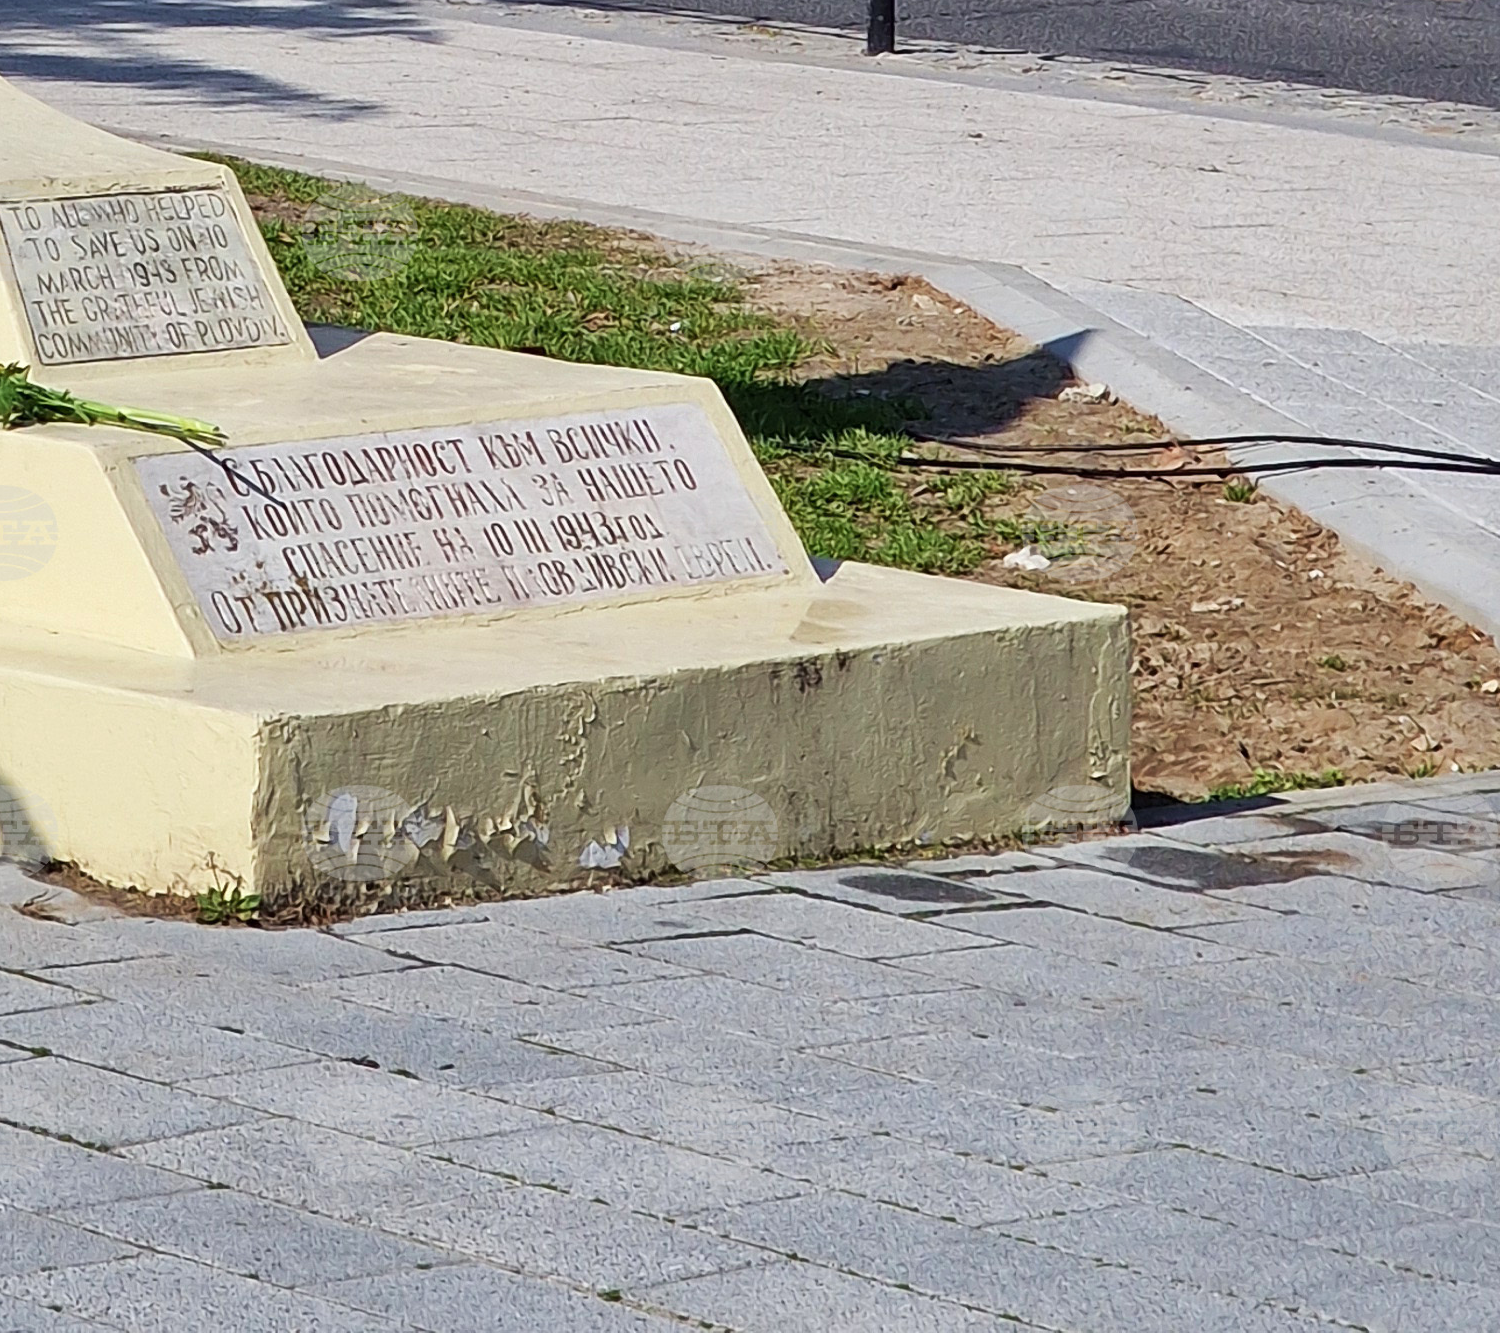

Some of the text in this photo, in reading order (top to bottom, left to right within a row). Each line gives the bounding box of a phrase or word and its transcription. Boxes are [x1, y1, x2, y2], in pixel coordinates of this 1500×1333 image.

[7, 193, 226, 232] TO ALL WHO HELPED
[27, 237, 61, 262] TO
[71, 231, 128, 262] SAVE
[130, 228, 160, 254] US
[170, 225, 199, 252] ON
[38, 264, 116, 295] MARCH
[181, 255, 246, 283] FROM
[31, 300, 79, 329] THE
[187, 285, 265, 315] JEWISH
[165, 322, 191, 349] OF
[478, 430, 546, 470] КЪМ
[241, 497, 343, 541] КОИТО
[531, 473, 573, 507] ЗА
[577, 459, 698, 503] НАШЕТО
[482, 522, 515, 558] 10
